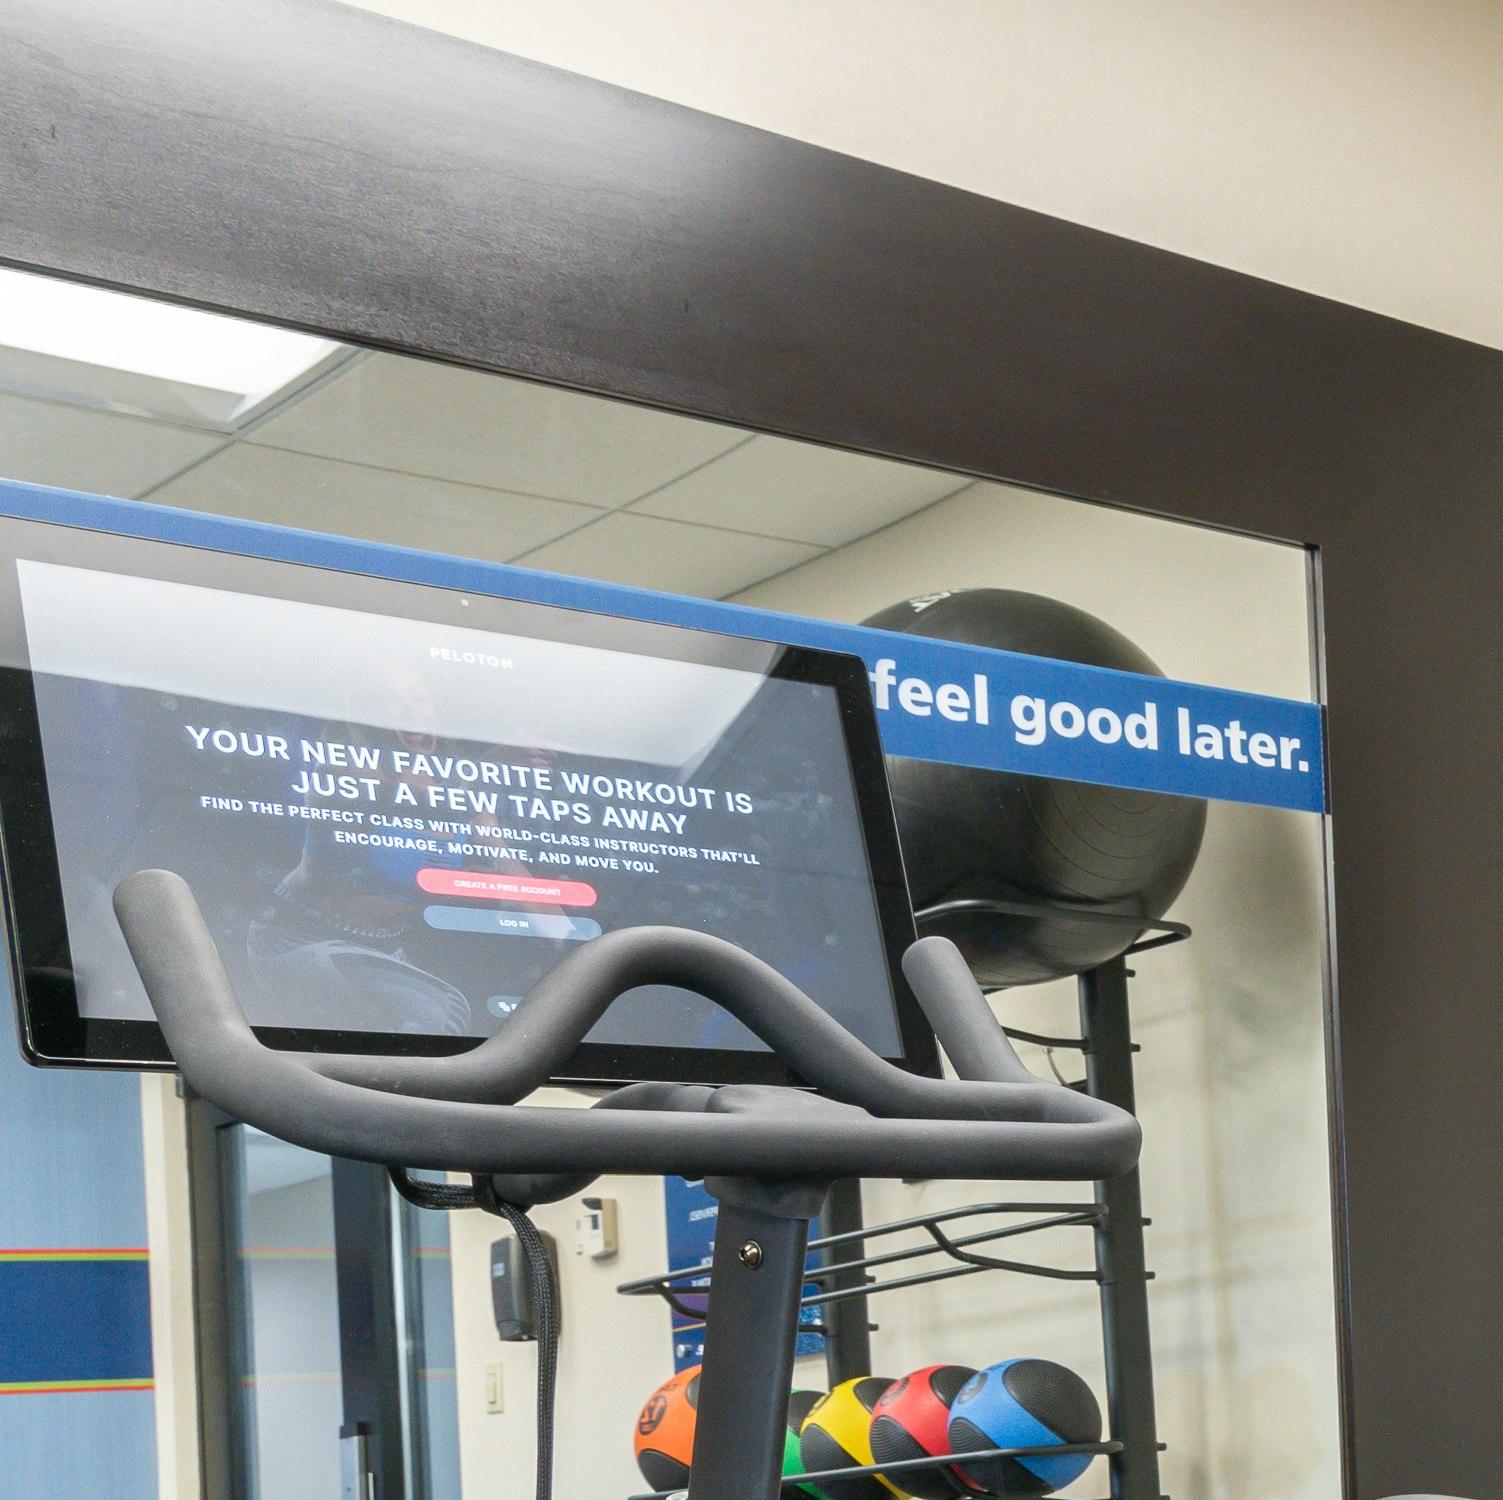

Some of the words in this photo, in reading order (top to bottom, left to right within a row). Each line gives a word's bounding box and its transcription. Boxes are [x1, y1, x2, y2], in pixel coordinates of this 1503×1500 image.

[429, 646, 513, 670] PELOTON
[869, 658, 989, 725] feel
[1010, 694, 1158, 750] good
[1177, 707, 1310, 773] later.
[185, 725, 290, 760] YOUR
[301, 739, 380, 770] NEW
[392, 751, 553, 791] FAVORITE
[560, 771, 716, 810] WORKOUT
[725, 791, 754, 815] IS
[200, 795, 244, 811] FIND
[248, 801, 284, 816] THE
[288, 805, 364, 825] PERFECT
[369, 814, 425, 831] CLASS
[428, 819, 472, 835] WITH
[475, 824, 590, 848] WORLD-CLASS
[594, 837, 698, 859] INSTRUCTORS
[701, 848, 760, 865] THAT'LL
[291, 771, 380, 801] JUST
[394, 782, 418, 806] A
[426, 786, 498, 815] FEW
[507, 795, 592, 825] TAPS
[602, 806, 687, 835] AWAY
[334, 830, 444, 854] ENCOURAGE,
[447, 842, 534, 863] MOTIVATE,
[539, 851, 571, 865] AND
[575, 855, 619, 870] MOVE
[622, 859, 659, 874] YOU.
[454, 879, 487, 890] CREATE
[489, 882, 497, 891] A
[498, 884, 519, 893] FREE
[520, 886, 561, 897] ACCOUNT
[499, 918, 518, 928] LOG
[519, 920, 530, 929] IN
